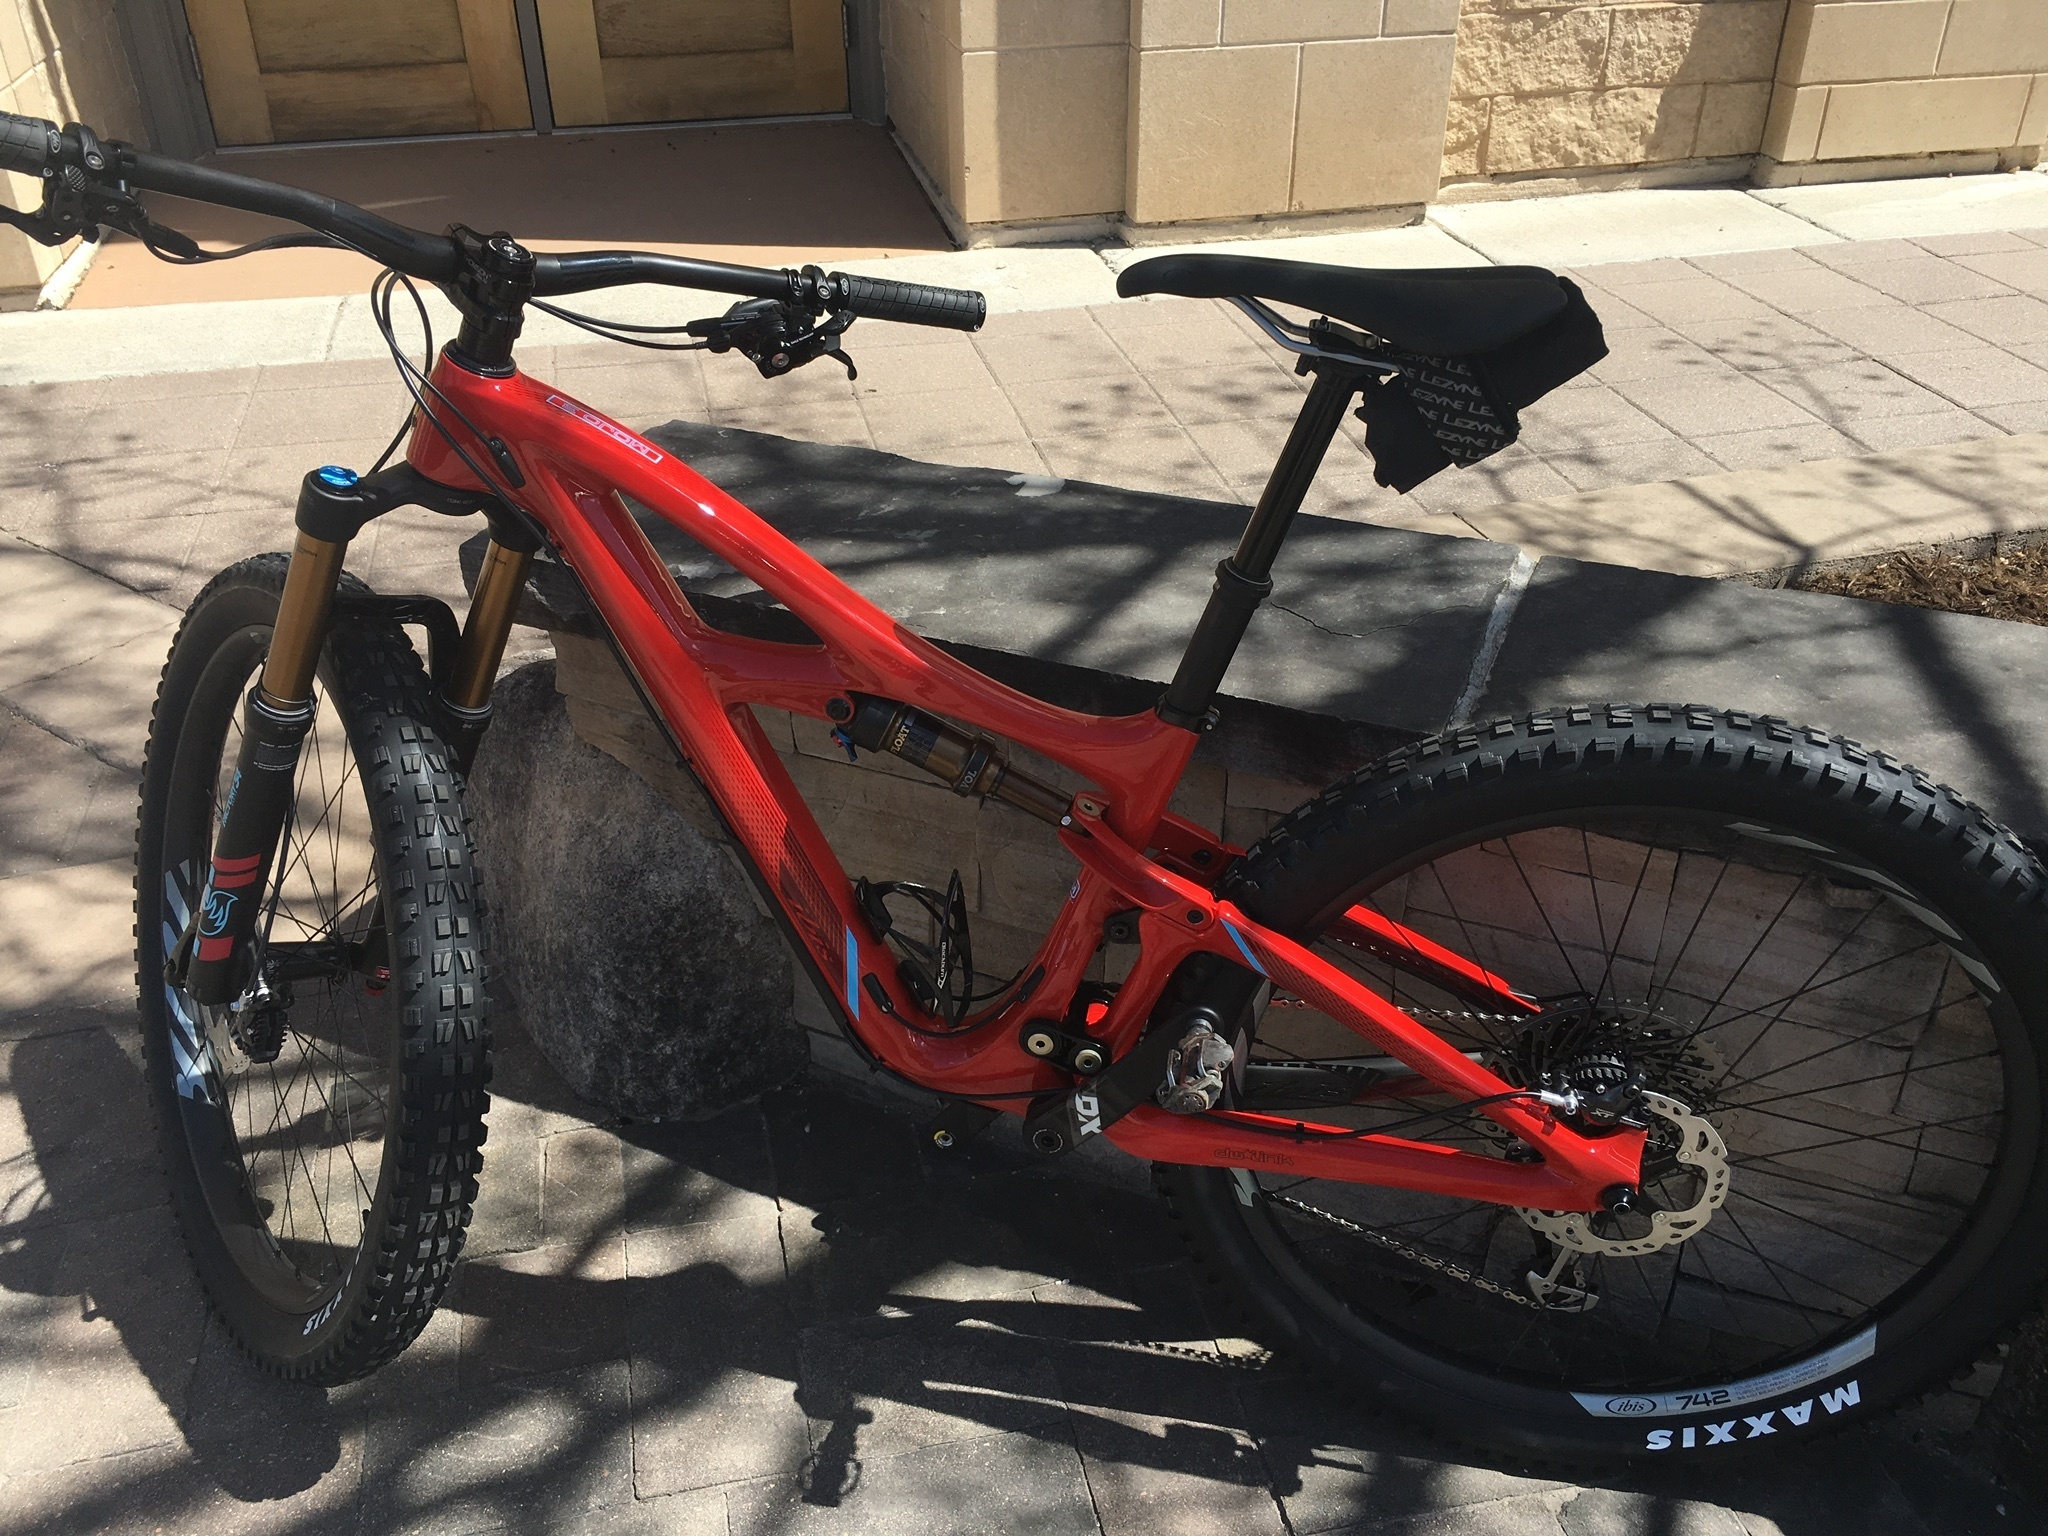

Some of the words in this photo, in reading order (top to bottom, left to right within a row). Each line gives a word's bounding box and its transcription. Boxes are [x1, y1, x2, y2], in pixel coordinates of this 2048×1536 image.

[1420, 370, 1482, 397] LEZYNE
[1443, 413, 1505, 436] LEZYNE
[1616, 1396, 1645, 1413] ibis
[1675, 1388, 1733, 1411] 742
[1646, 1379, 1861, 1450] MAXXIS
